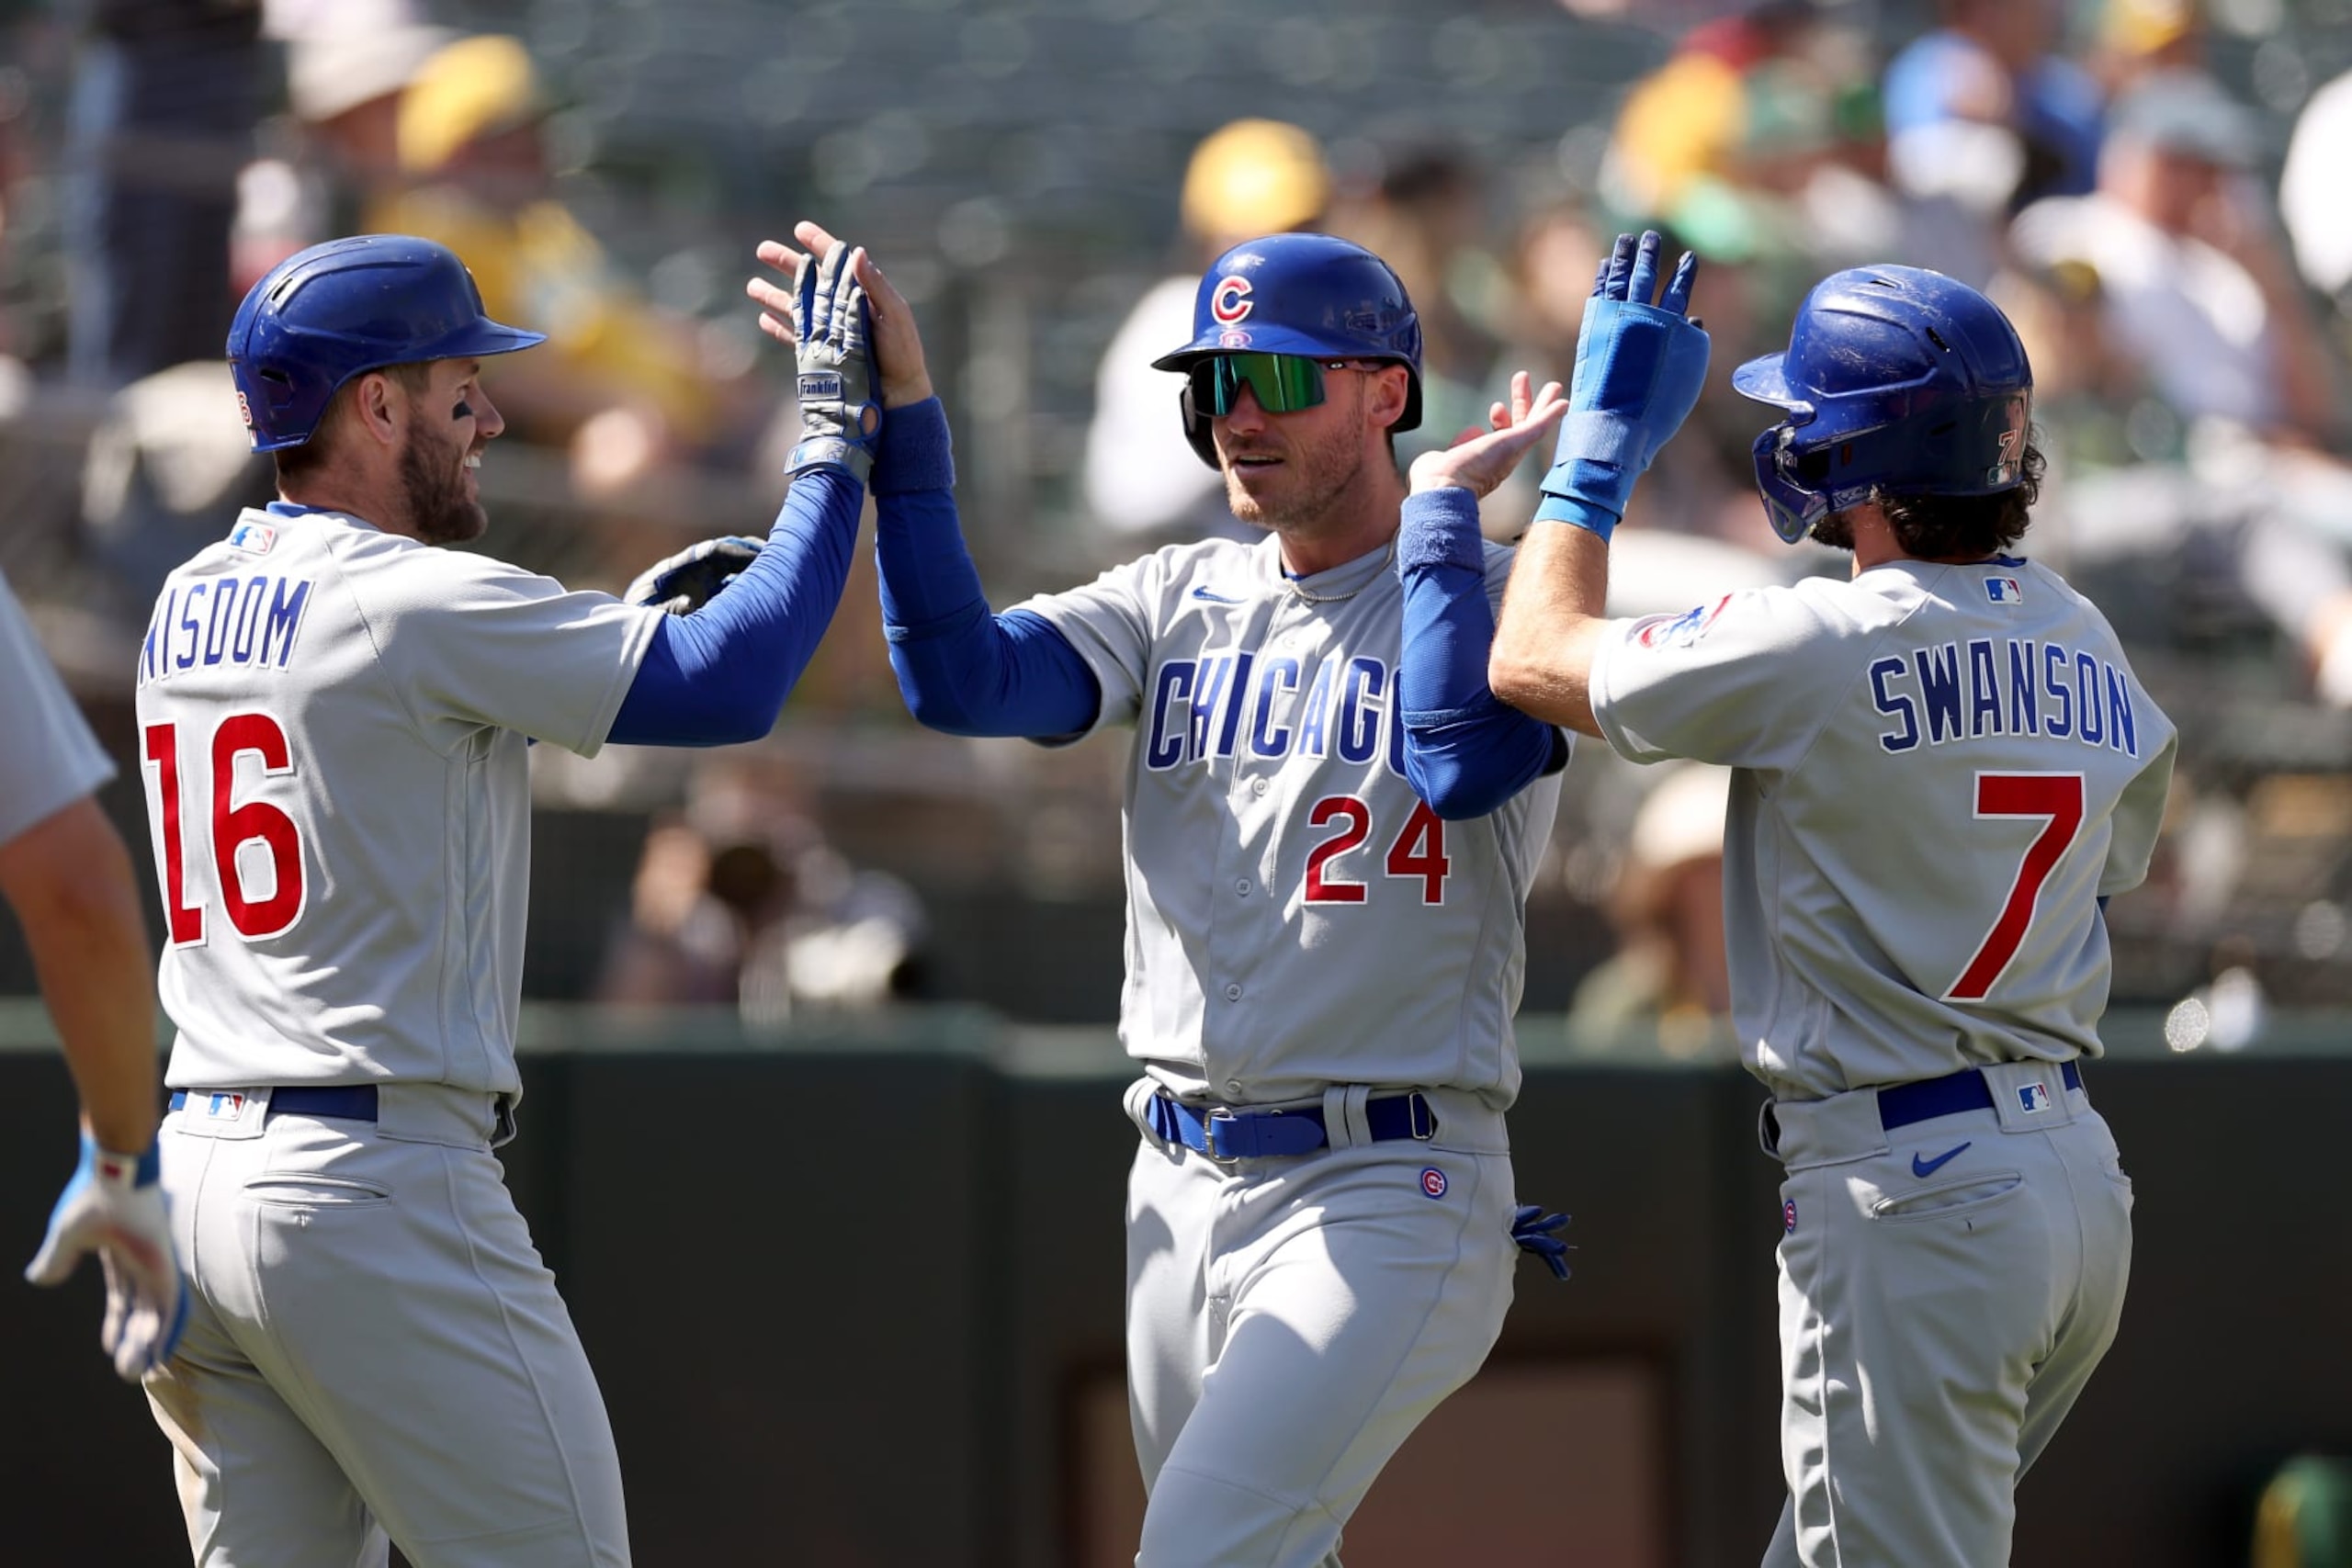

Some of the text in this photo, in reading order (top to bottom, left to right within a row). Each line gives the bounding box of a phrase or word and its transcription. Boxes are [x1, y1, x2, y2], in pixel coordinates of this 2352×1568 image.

[1211, 276, 1254, 324] C
[1997, 429, 2018, 467] 7
[1867, 638, 2139, 759] SWANSON
[143, 710, 308, 950] 16
[1302, 794, 1452, 906] 24
[1939, 770, 2086, 1003] 7
